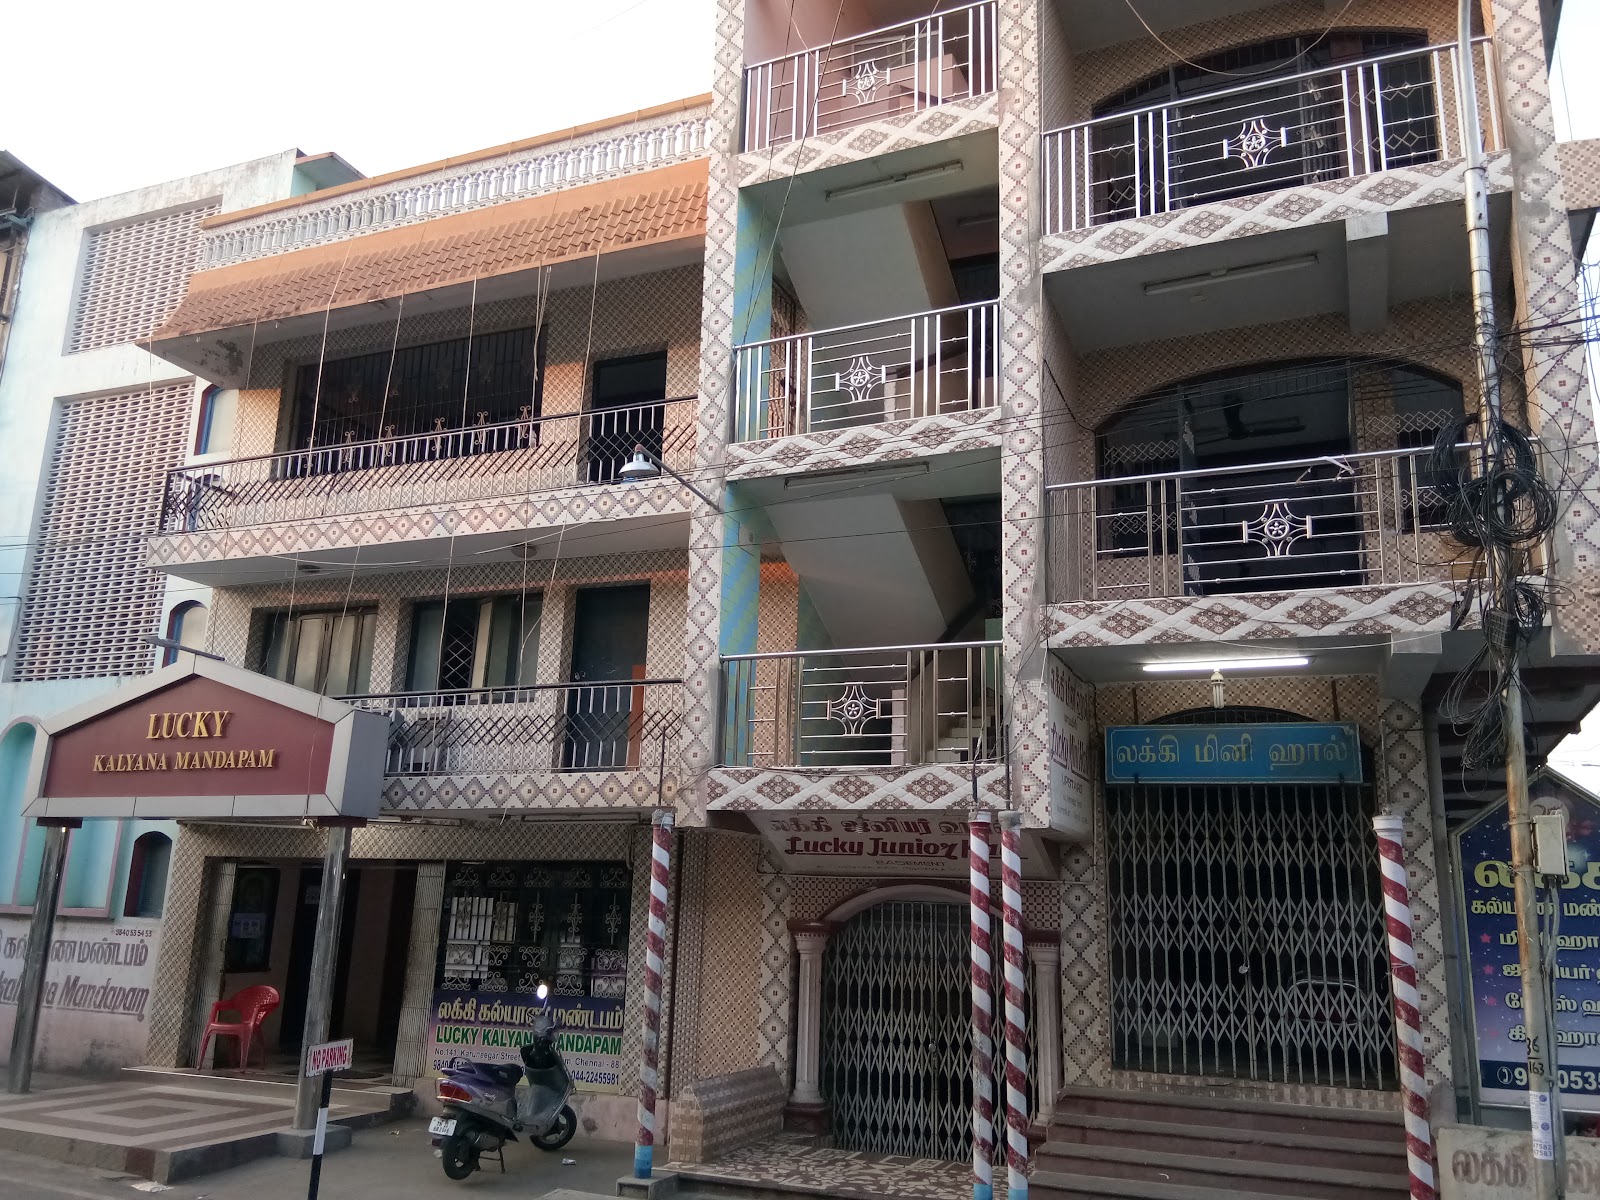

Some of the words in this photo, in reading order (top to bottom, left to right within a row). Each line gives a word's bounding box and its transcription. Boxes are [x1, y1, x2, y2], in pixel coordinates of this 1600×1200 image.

[146, 710, 230, 739] LUCKY
[93, 752, 167, 772] KALYANA
[174, 749, 275, 770] MANDAPAM
[1116, 734, 1180, 763] லக்கி
[1195, 733, 1253, 762] மினி
[1269, 735, 1347, 771] ஹால்
[784, 836, 864, 856] Lucky
[867, 837, 958, 860] Junior
[58, 975, 149, 1012] Mandapam
[438, 997, 477, 1022] லக்கி
[436, 1025, 479, 1043] LUCKY
[481, 1027, 534, 1048] KALYAN
[557, 1032, 622, 1056] ANDAPAM
[312, 1049, 321, 1071] NO
[322, 1045, 347, 1068] PARKING
[500, 1051, 521, 1061] Street
[575, 1057, 604, 1067] Chennai
